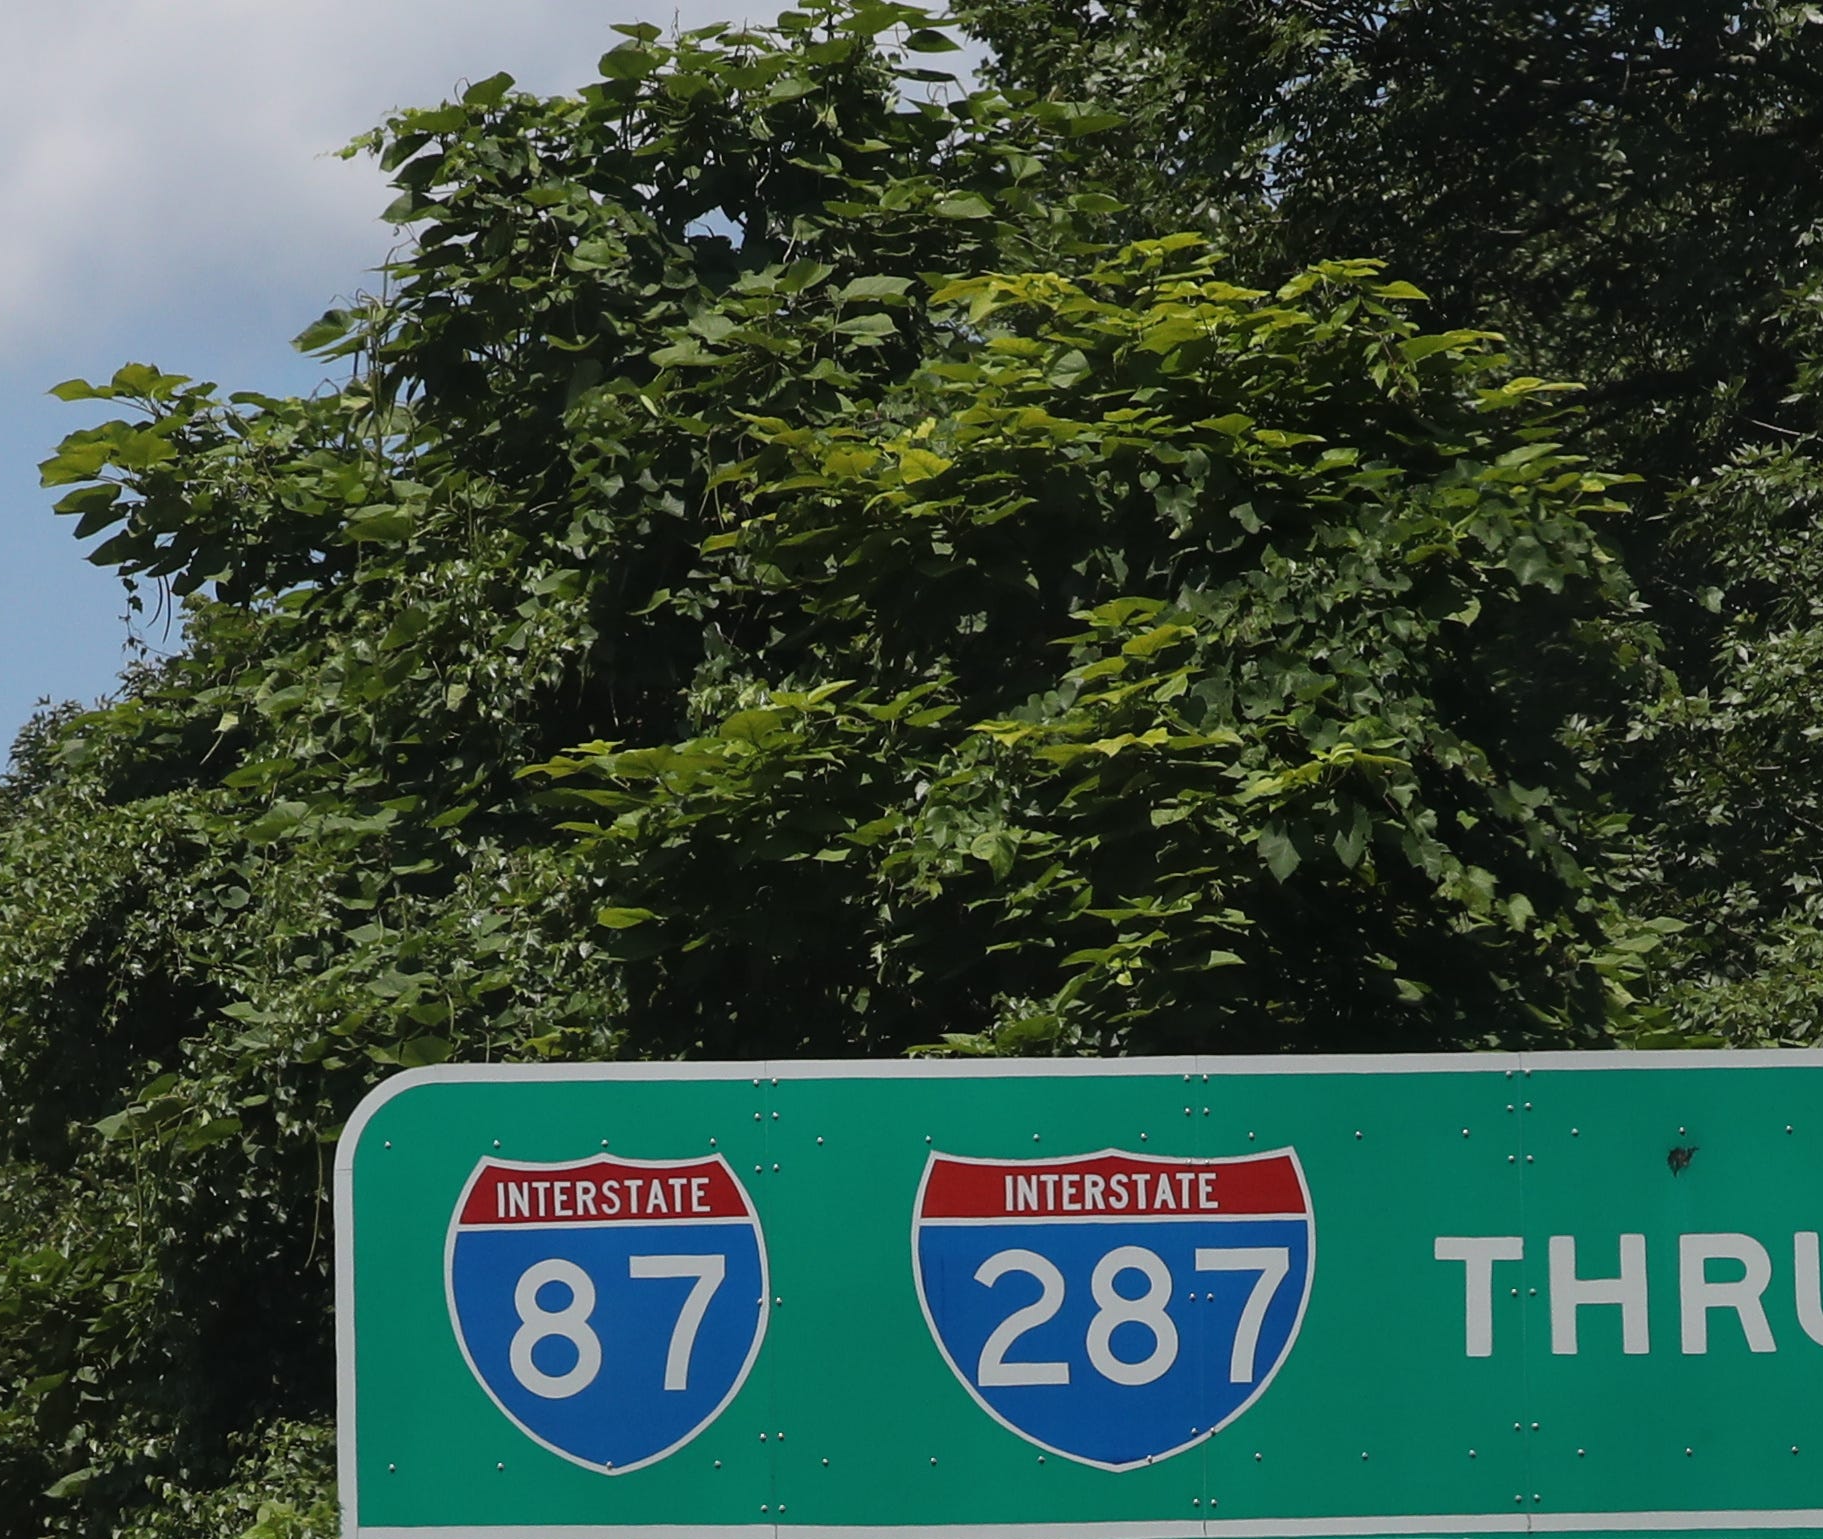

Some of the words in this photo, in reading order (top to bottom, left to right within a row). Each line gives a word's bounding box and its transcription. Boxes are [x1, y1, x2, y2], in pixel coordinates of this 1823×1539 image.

[495, 1176, 712, 1219] INTERSTATE
[1003, 1171, 1220, 1213] INTERSTATE
[508, 1253, 726, 1400] 87
[972, 1244, 1291, 1388] 287
